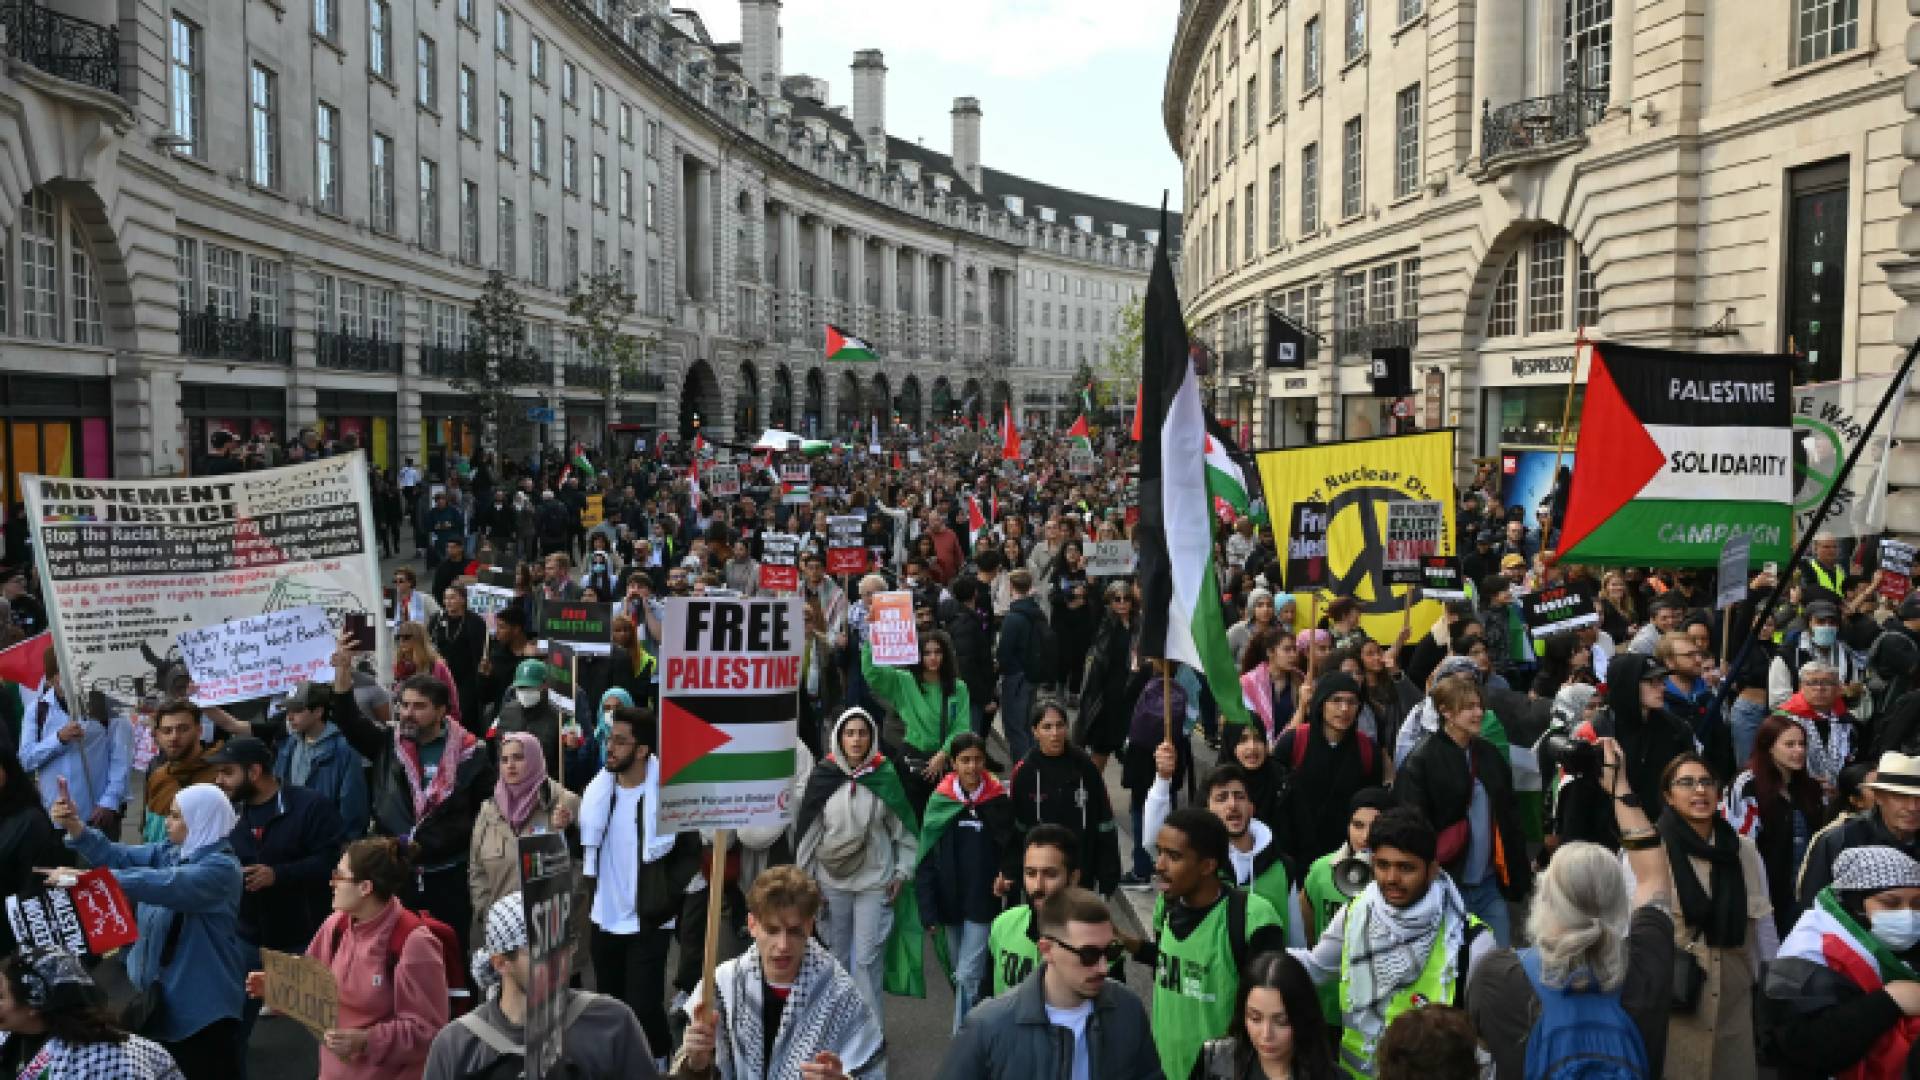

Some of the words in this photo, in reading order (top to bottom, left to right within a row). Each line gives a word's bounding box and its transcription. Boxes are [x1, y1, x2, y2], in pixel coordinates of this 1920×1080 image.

[1669, 378, 1775, 403] PALESTINE
[1670, 450, 1787, 477] SOLIDARITY
[1324, 465, 1402, 491] Nuclear
[40, 481, 235, 505] MOVEMENT
[105, 503, 237, 523] JUSTICE
[112, 526, 160, 541] Racist
[1658, 522, 1781, 545] CAMPAIGN
[684, 602, 792, 652] FREE
[667, 655, 800, 689] PALESTINE
[531, 892, 571, 959] STOP
